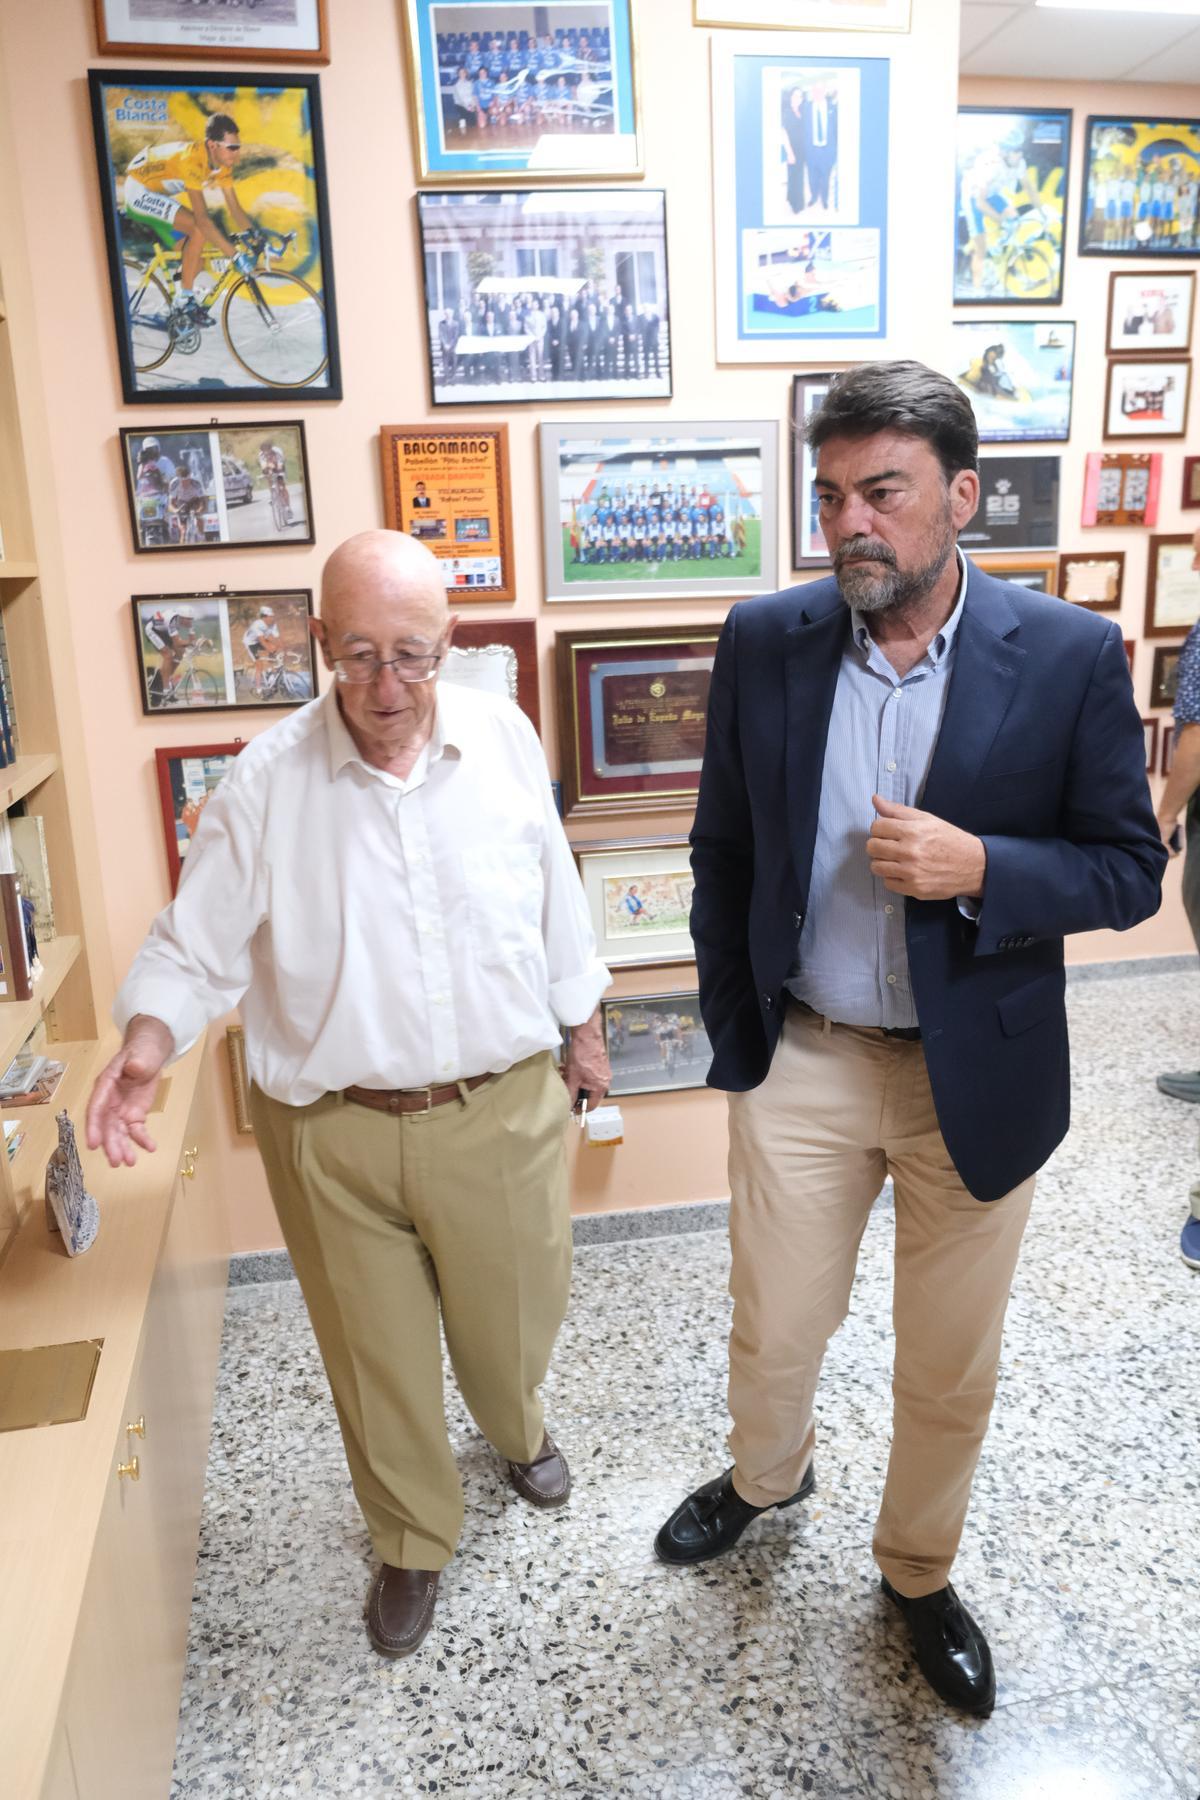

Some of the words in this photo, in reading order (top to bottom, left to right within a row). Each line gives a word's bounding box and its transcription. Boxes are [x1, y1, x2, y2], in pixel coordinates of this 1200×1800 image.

[123, 96, 167, 110] Costa
[115, 108, 168, 121] Blanca
[142, 193, 166, 207] Costa
[133, 199, 163, 216] Blanca
[403, 441, 489, 455] BALONMANO
[986, 494, 1020, 512] 25
